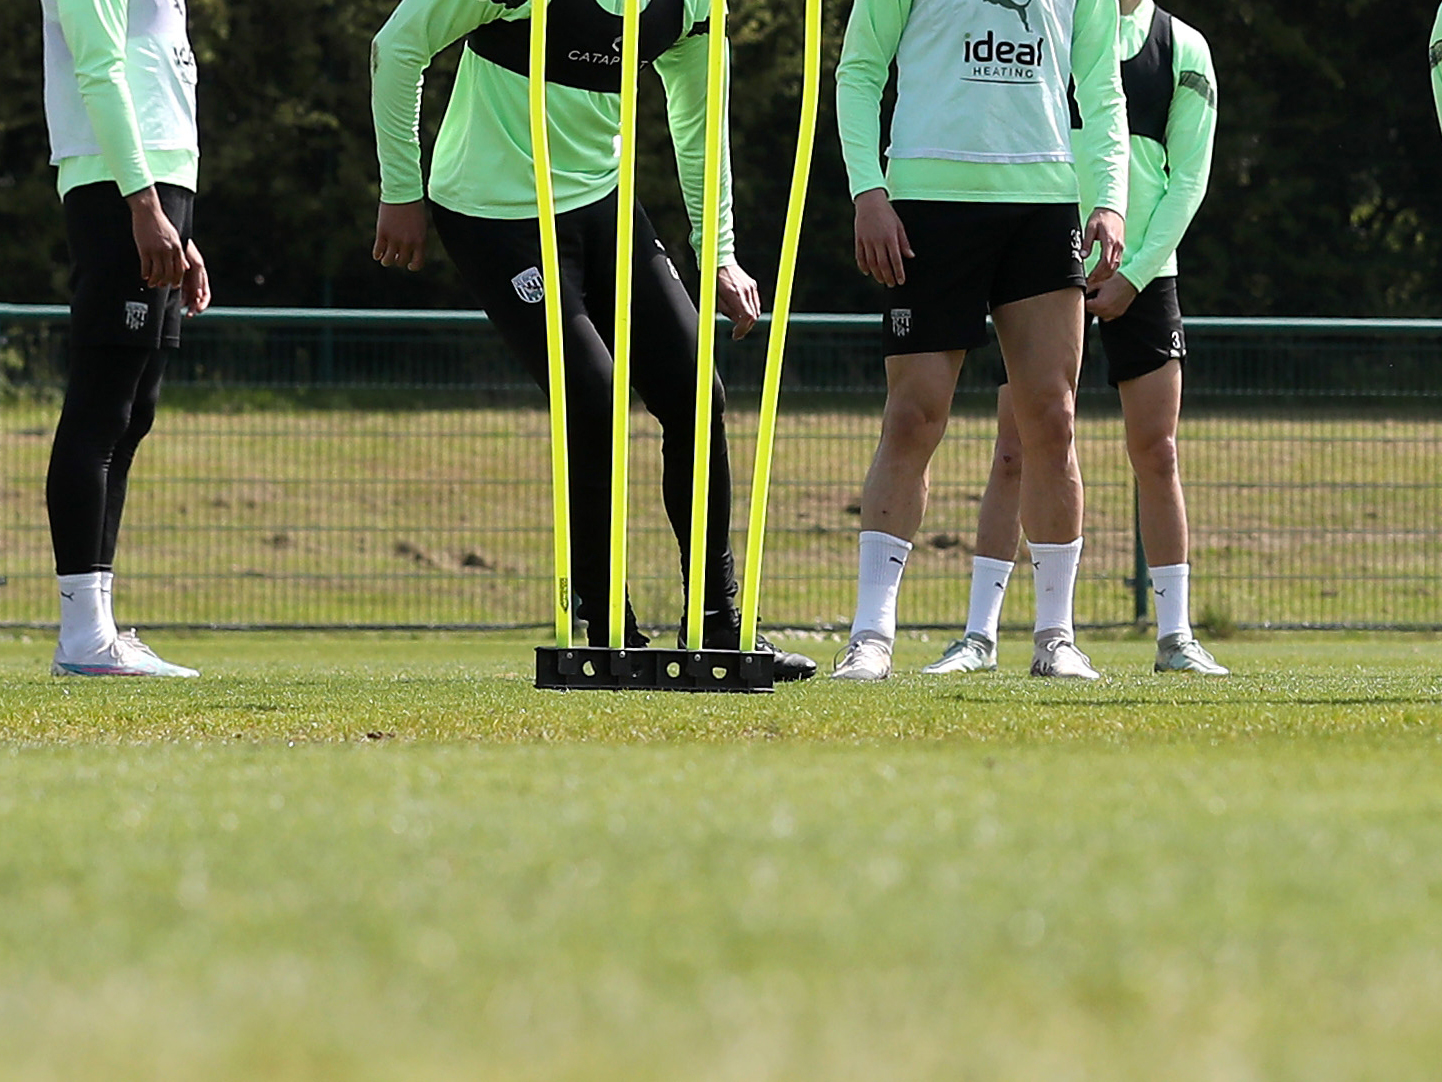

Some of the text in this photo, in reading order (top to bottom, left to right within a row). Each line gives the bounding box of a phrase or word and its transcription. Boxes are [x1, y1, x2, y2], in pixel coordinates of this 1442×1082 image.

[964, 30, 1044, 67] ideal
[568, 50, 648, 70] CATAPT
[973, 67, 1034, 78] HEATING
[1171, 331, 1181, 349] 3
